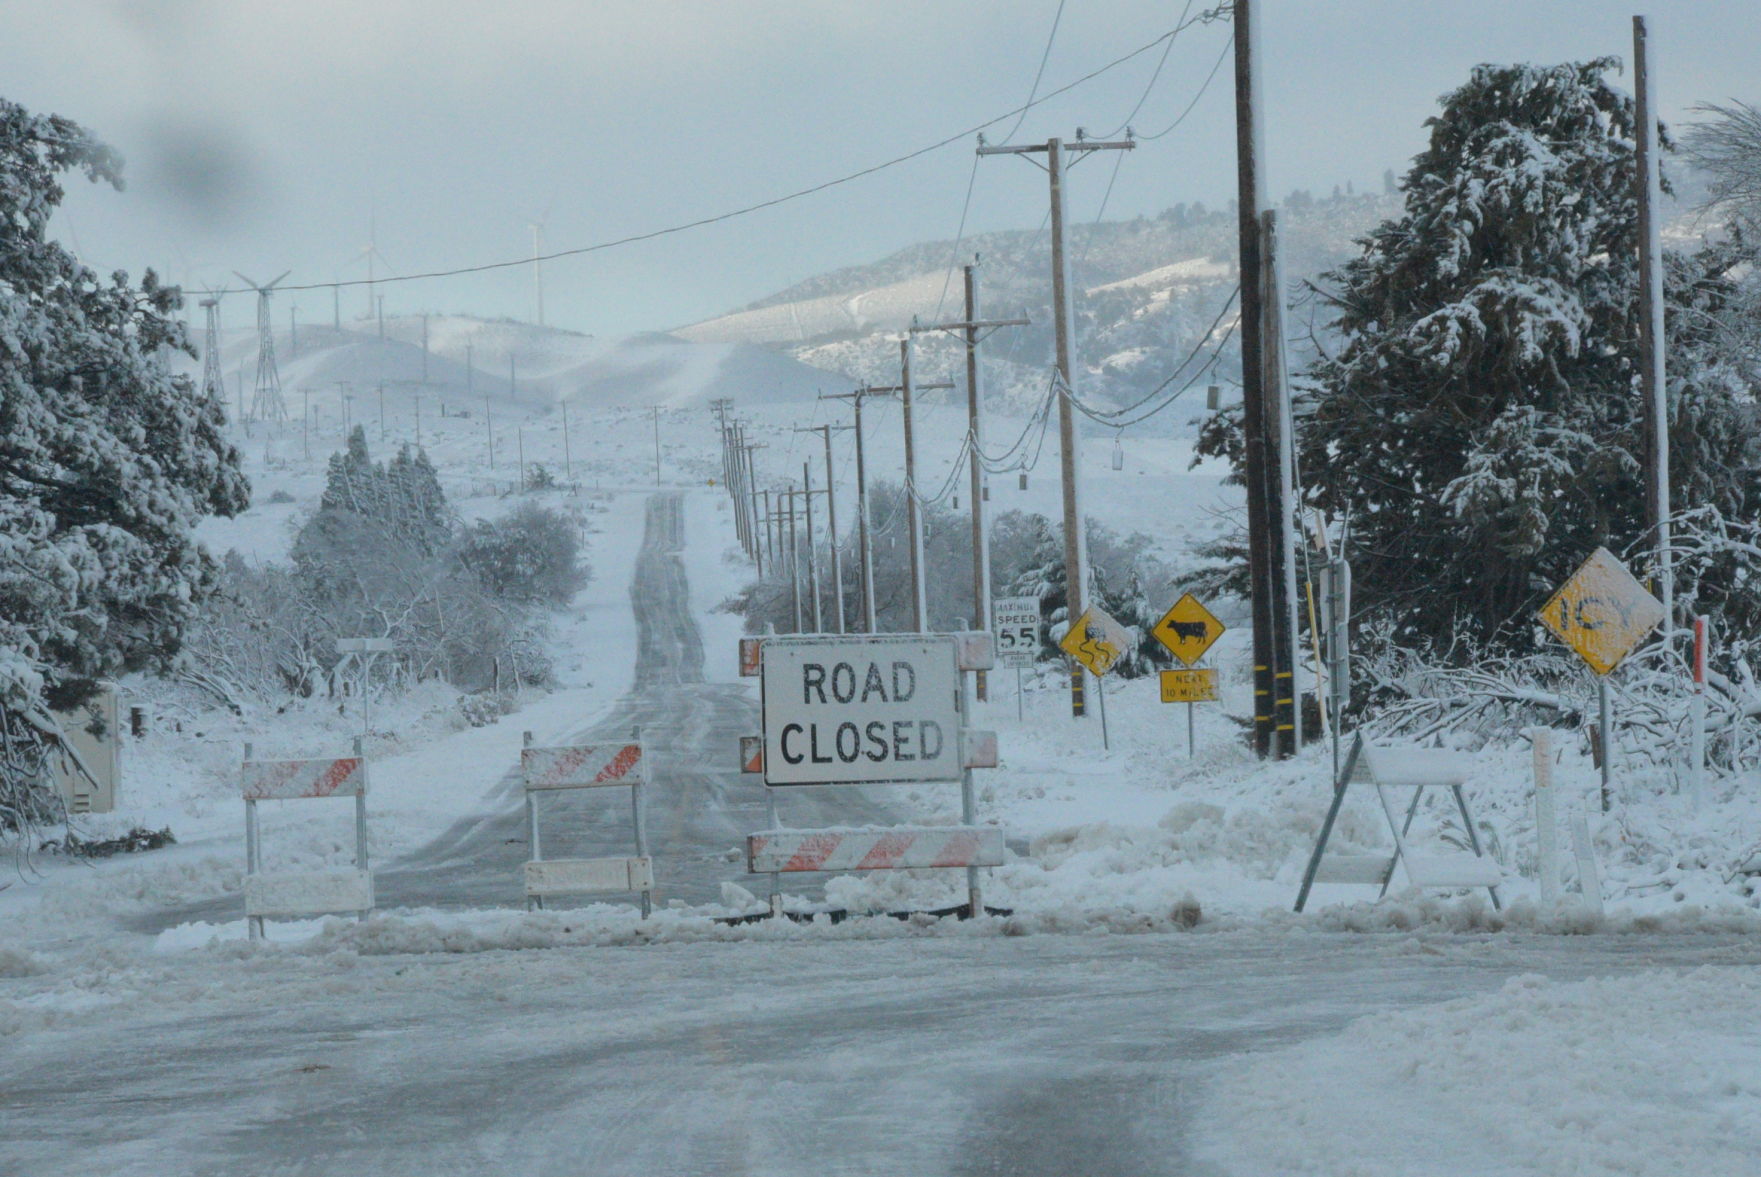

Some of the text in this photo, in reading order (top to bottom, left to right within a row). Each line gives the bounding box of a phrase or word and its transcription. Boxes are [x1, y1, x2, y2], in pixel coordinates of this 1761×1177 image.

[998, 615, 1037, 624] SPEED
[1561, 596, 1636, 630] ICY
[1000, 627, 1035, 648] 55
[803, 661, 916, 704] ROAD
[1175, 674, 1205, 684] NEXT
[1166, 686, 1214, 697] 10 MILES
[781, 720, 943, 764] CLOSED
